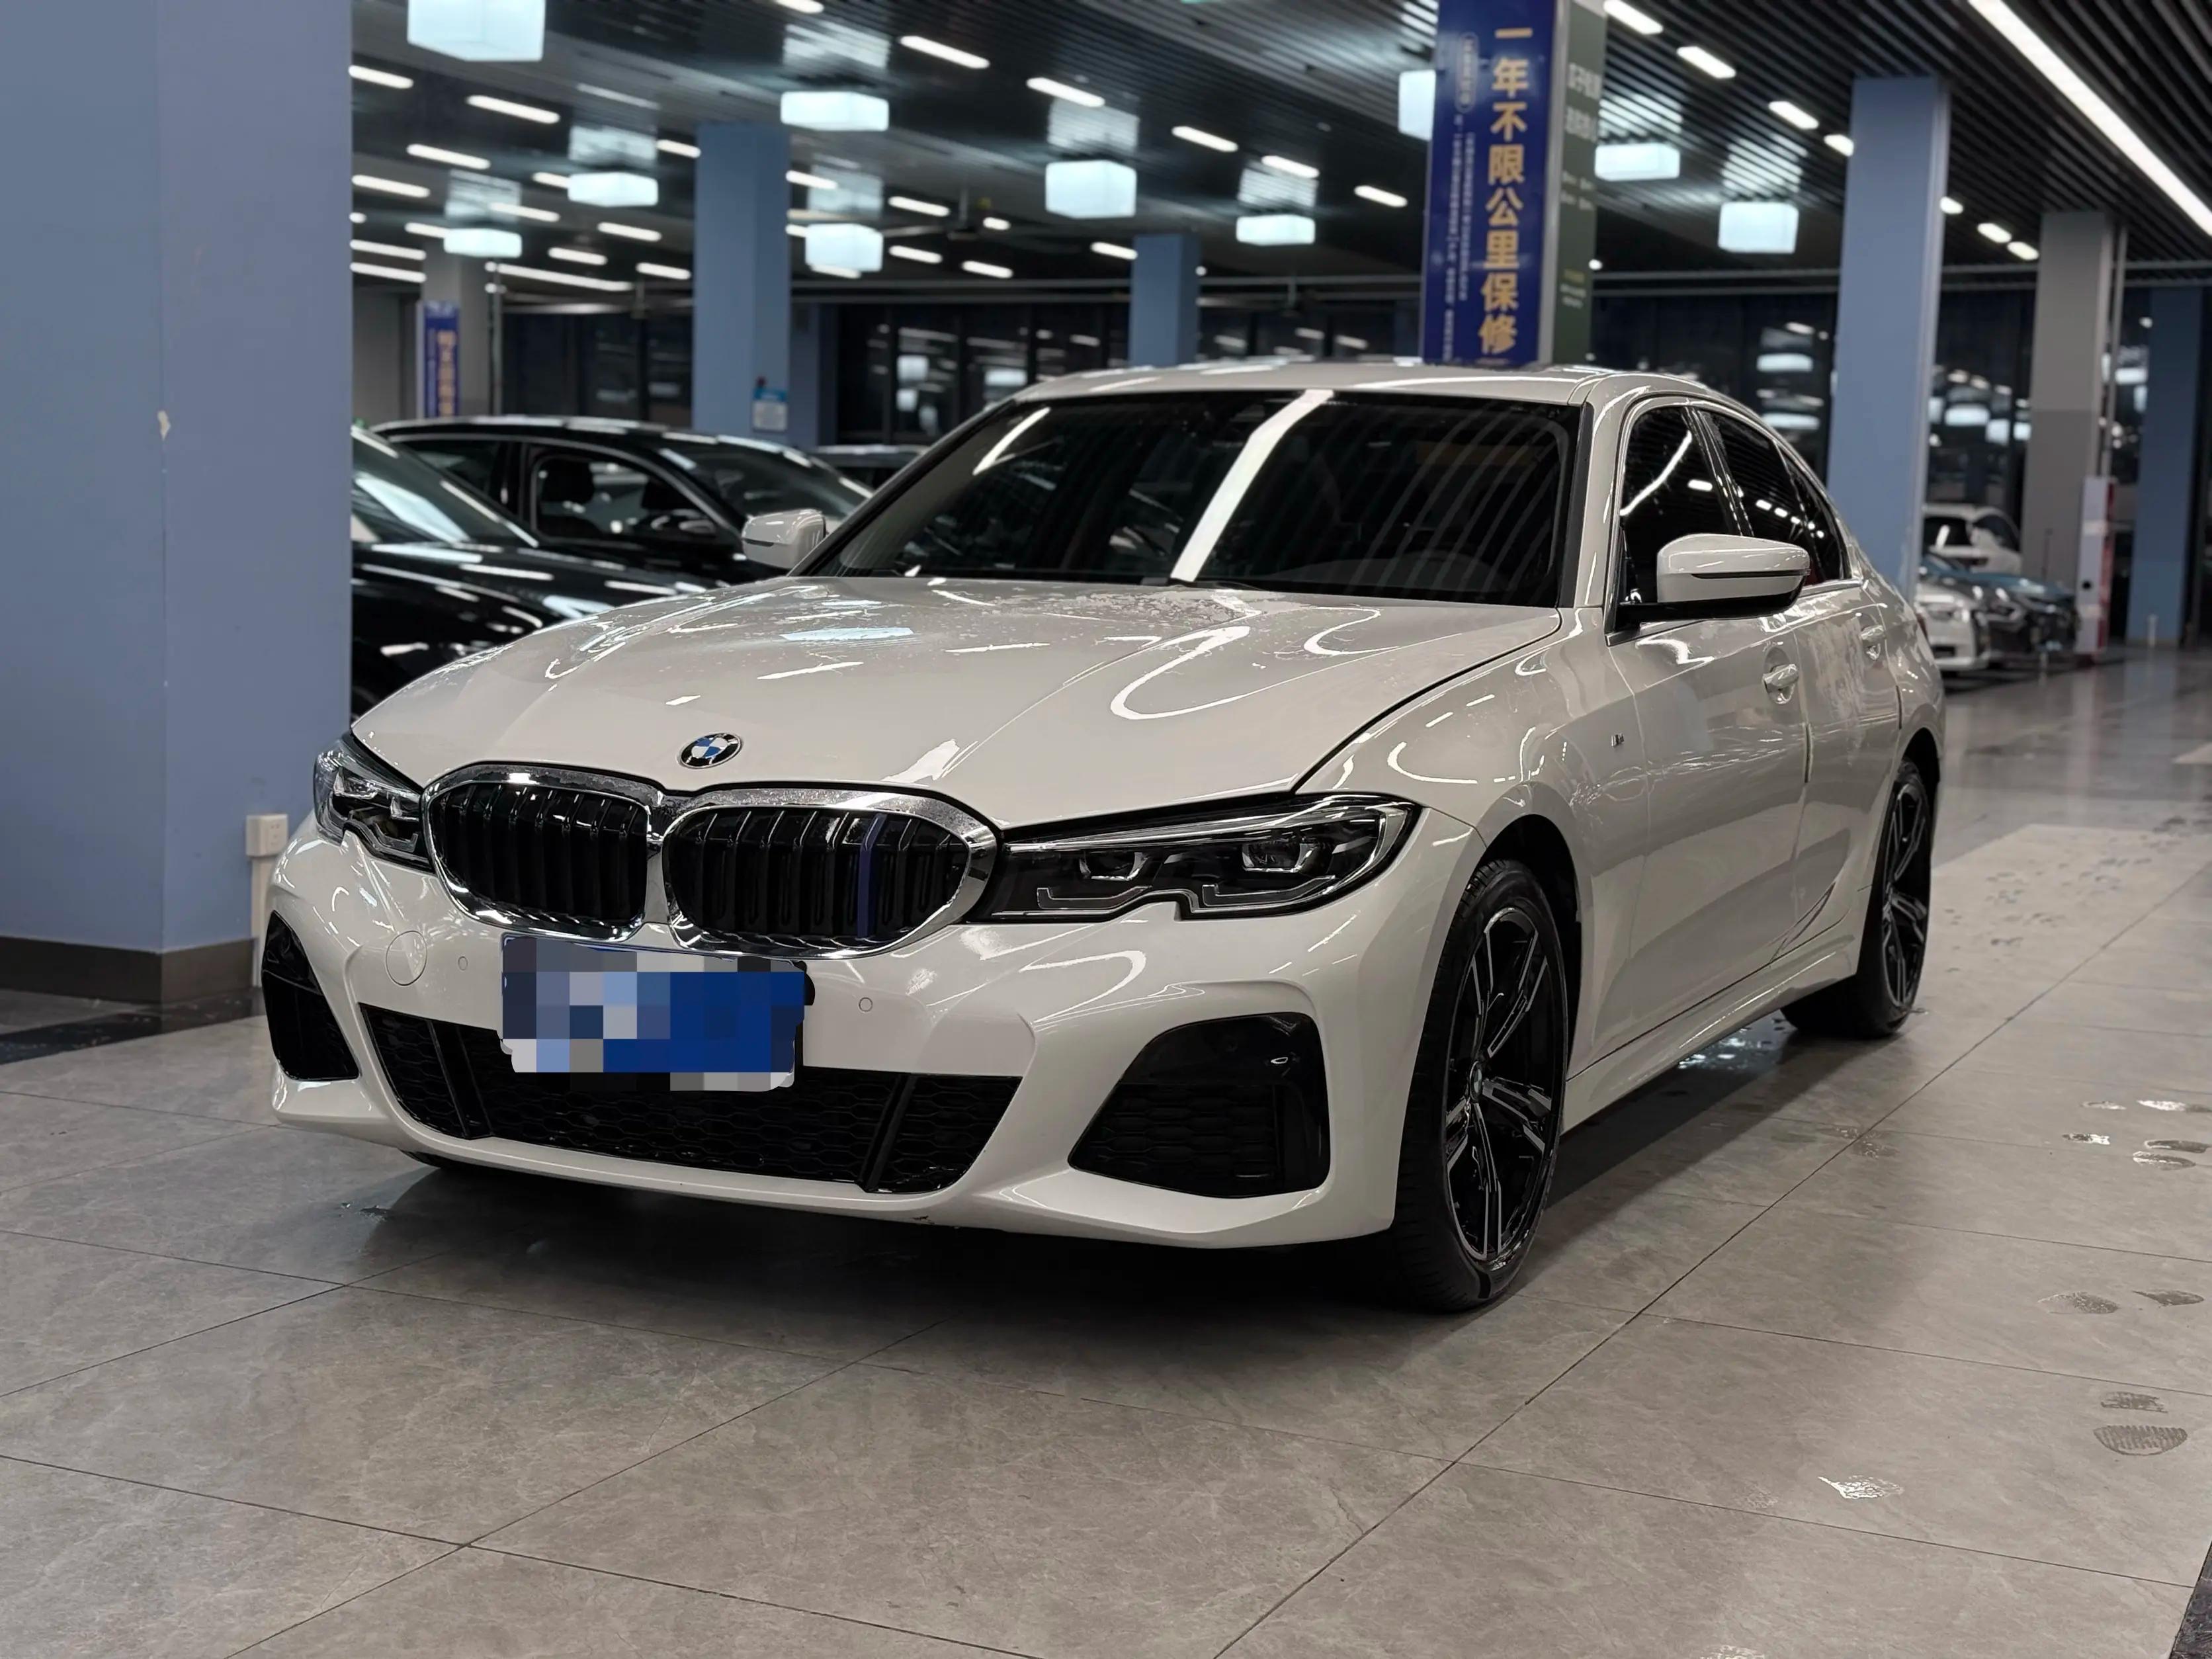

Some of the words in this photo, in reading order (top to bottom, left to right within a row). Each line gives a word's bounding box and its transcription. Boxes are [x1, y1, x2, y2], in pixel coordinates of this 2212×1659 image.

[1478, 28, 1533, 354] 一年不限公里保修
